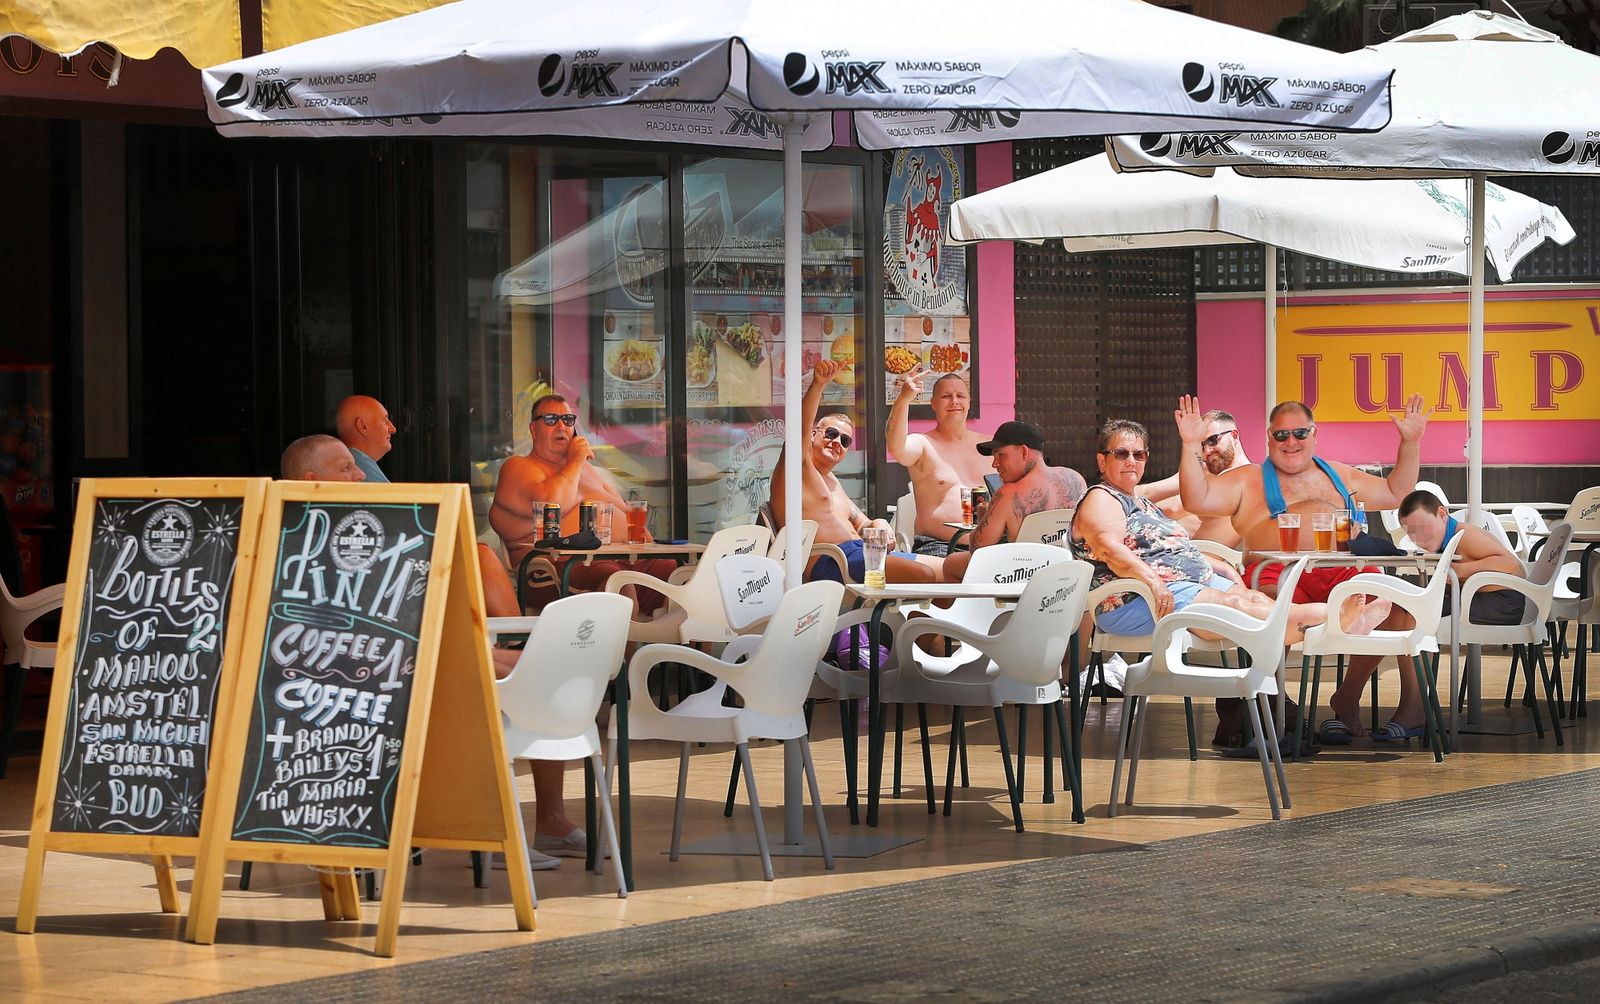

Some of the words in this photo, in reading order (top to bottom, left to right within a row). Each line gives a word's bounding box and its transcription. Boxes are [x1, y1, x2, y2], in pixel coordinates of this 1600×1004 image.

[821, 49, 849, 60] pepsi
[896, 60, 942, 72] MÁXIMO
[944, 62, 982, 72] SABOR
[1219, 62, 1246, 73] pepsi
[308, 75, 345, 87] MÁXIMO
[347, 72, 377, 85] SABOR
[567, 61, 624, 97] MAX
[825, 60, 891, 97] MAX
[903, 84, 931, 95] ZERO
[933, 81, 977, 95] AZÚCAR
[1287, 78, 1331, 92] MÁXIMO
[1332, 81, 1367, 94] SABOR
[246, 77, 303, 113] MAX
[1219, 73, 1282, 109] MAX
[304, 98, 329, 108] ZERO
[331, 95, 369, 107] AZÚCAR
[1290, 100, 1314, 112] ZERO
[1316, 101, 1355, 115] AZÚCAR
[1176, 132, 1240, 159] MAX
[1300, 132, 1338, 141] SABOR
[1251, 149, 1280, 158] ZERO
[1283, 147, 1328, 159] AZÚCAR
[922, 282, 957, 310] Benidorm
[151, 530, 185, 539] ESTRELLA
[339, 537, 375, 546] ESTRELLA
[96, 535, 220, 613] BOTTLES
[116, 619, 158, 651] OF
[187, 613, 217, 653] 2
[80, 722, 127, 745] SAN
[294, 722, 379, 758] BRANDY
[84, 742, 196, 769] ESTRELLA
[108, 780, 163, 820] BUD
